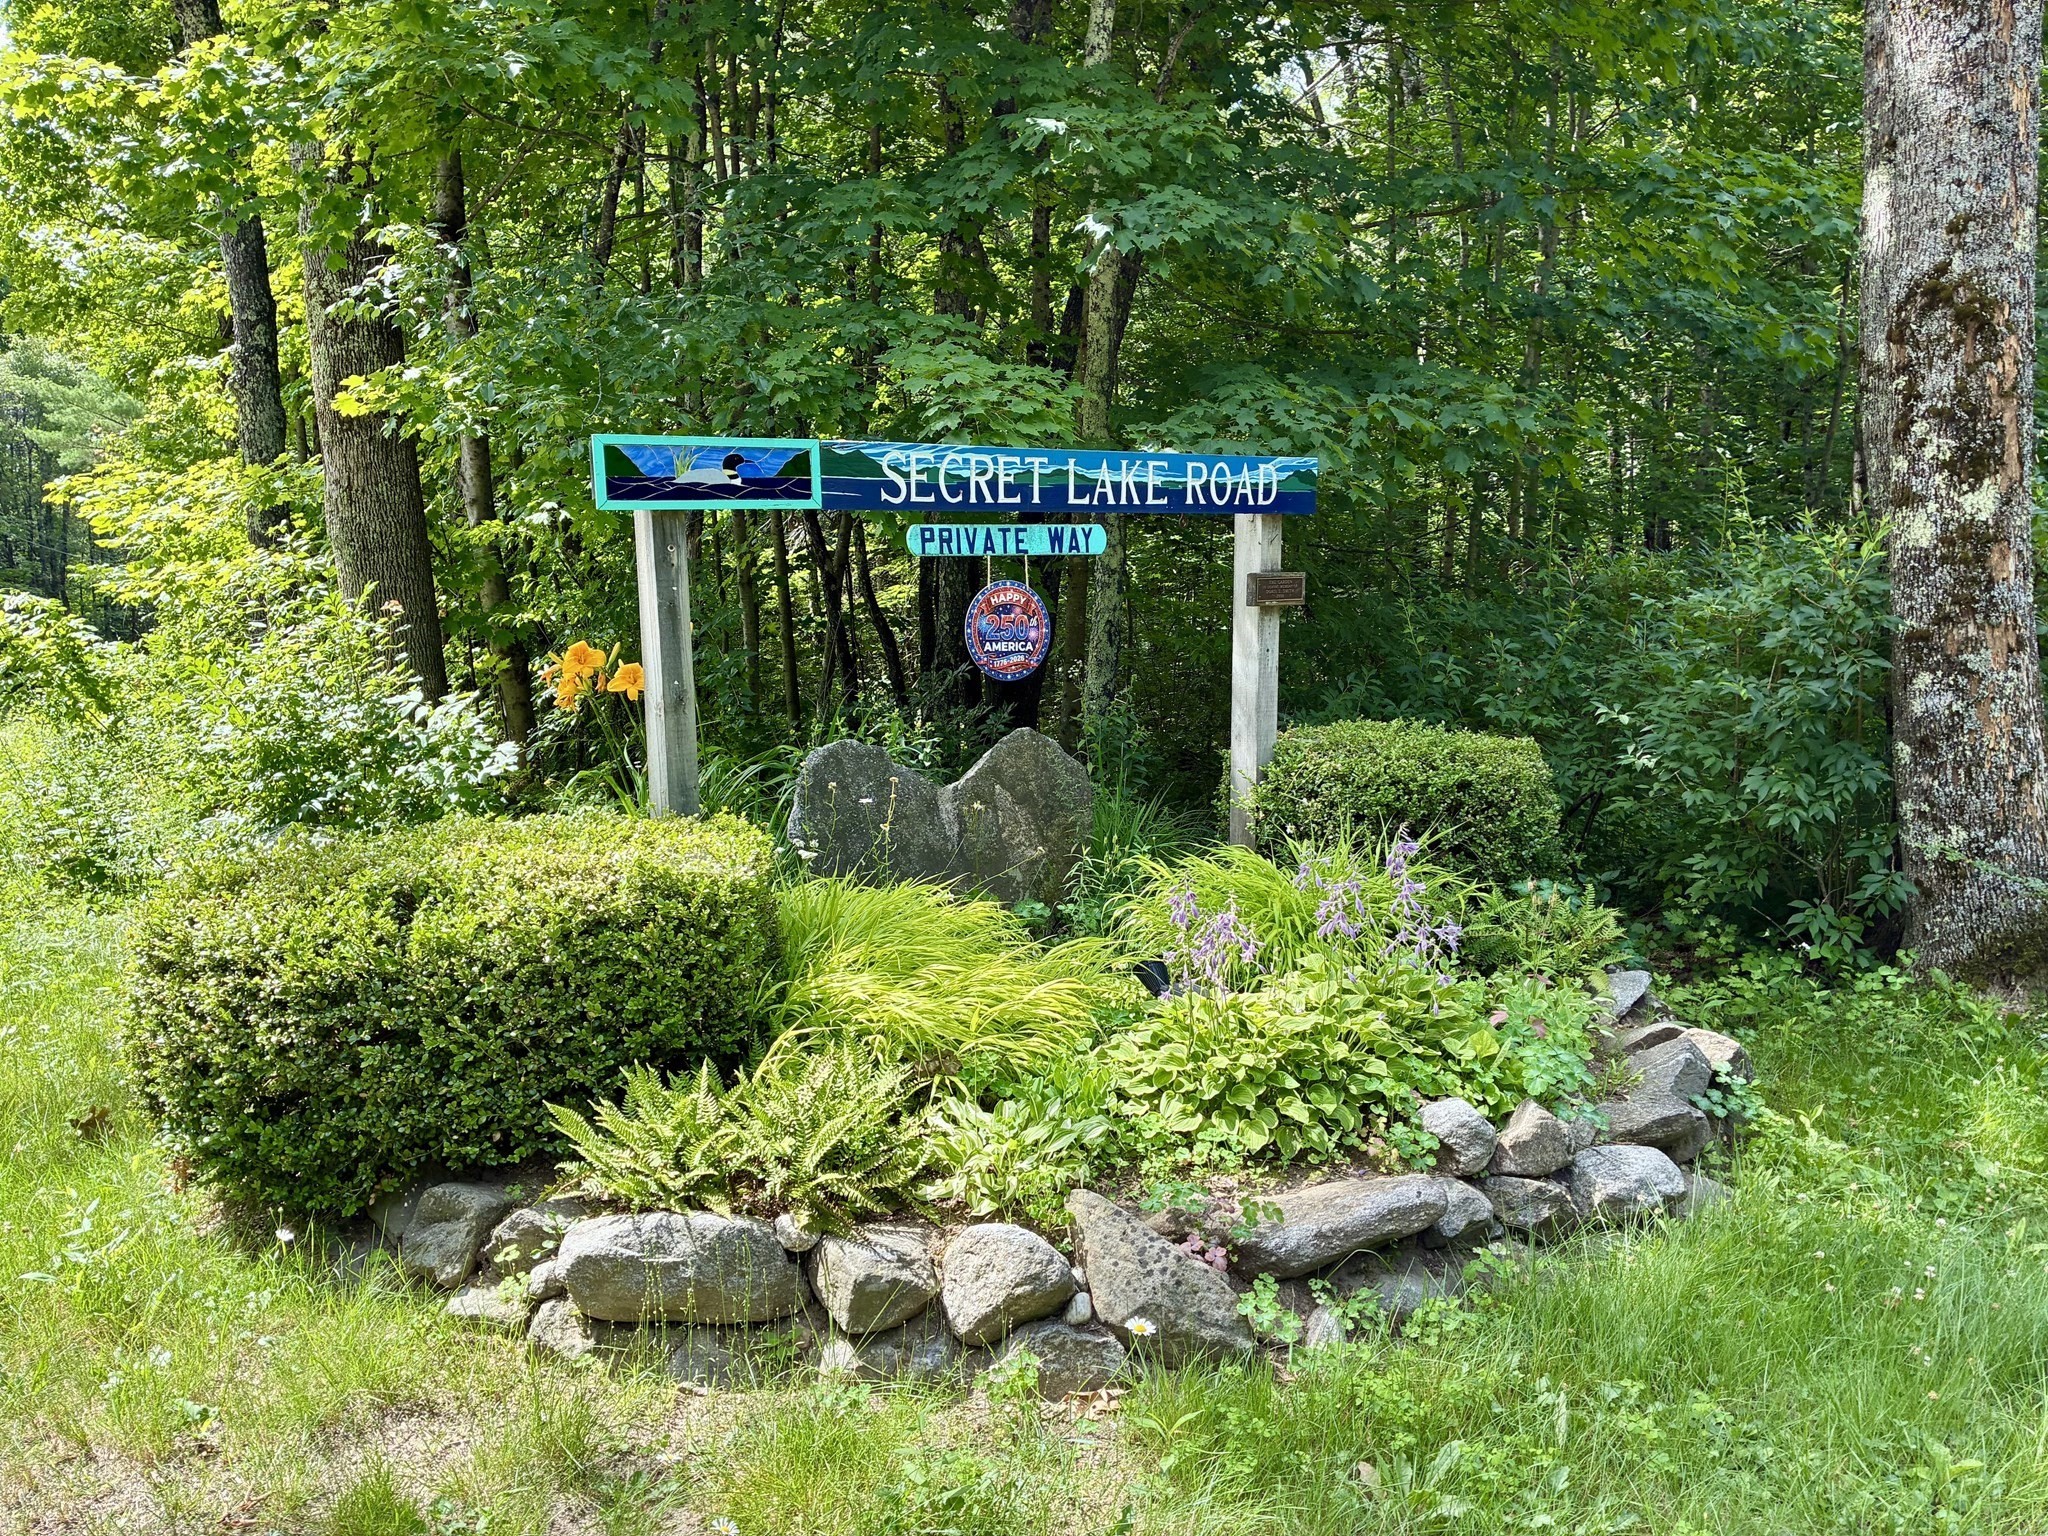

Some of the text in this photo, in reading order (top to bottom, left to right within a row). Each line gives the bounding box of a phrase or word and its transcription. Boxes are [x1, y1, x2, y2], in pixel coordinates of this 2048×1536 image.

[880, 450, 1278, 506] SECRET LAKE ROAD
[919, 526, 1093, 555] PRIVATE WAY
[990, 593, 1027, 606] HAPPY
[983, 641, 1034, 652] AMERICA
[993, 655, 1025, 668] 1776-2026
